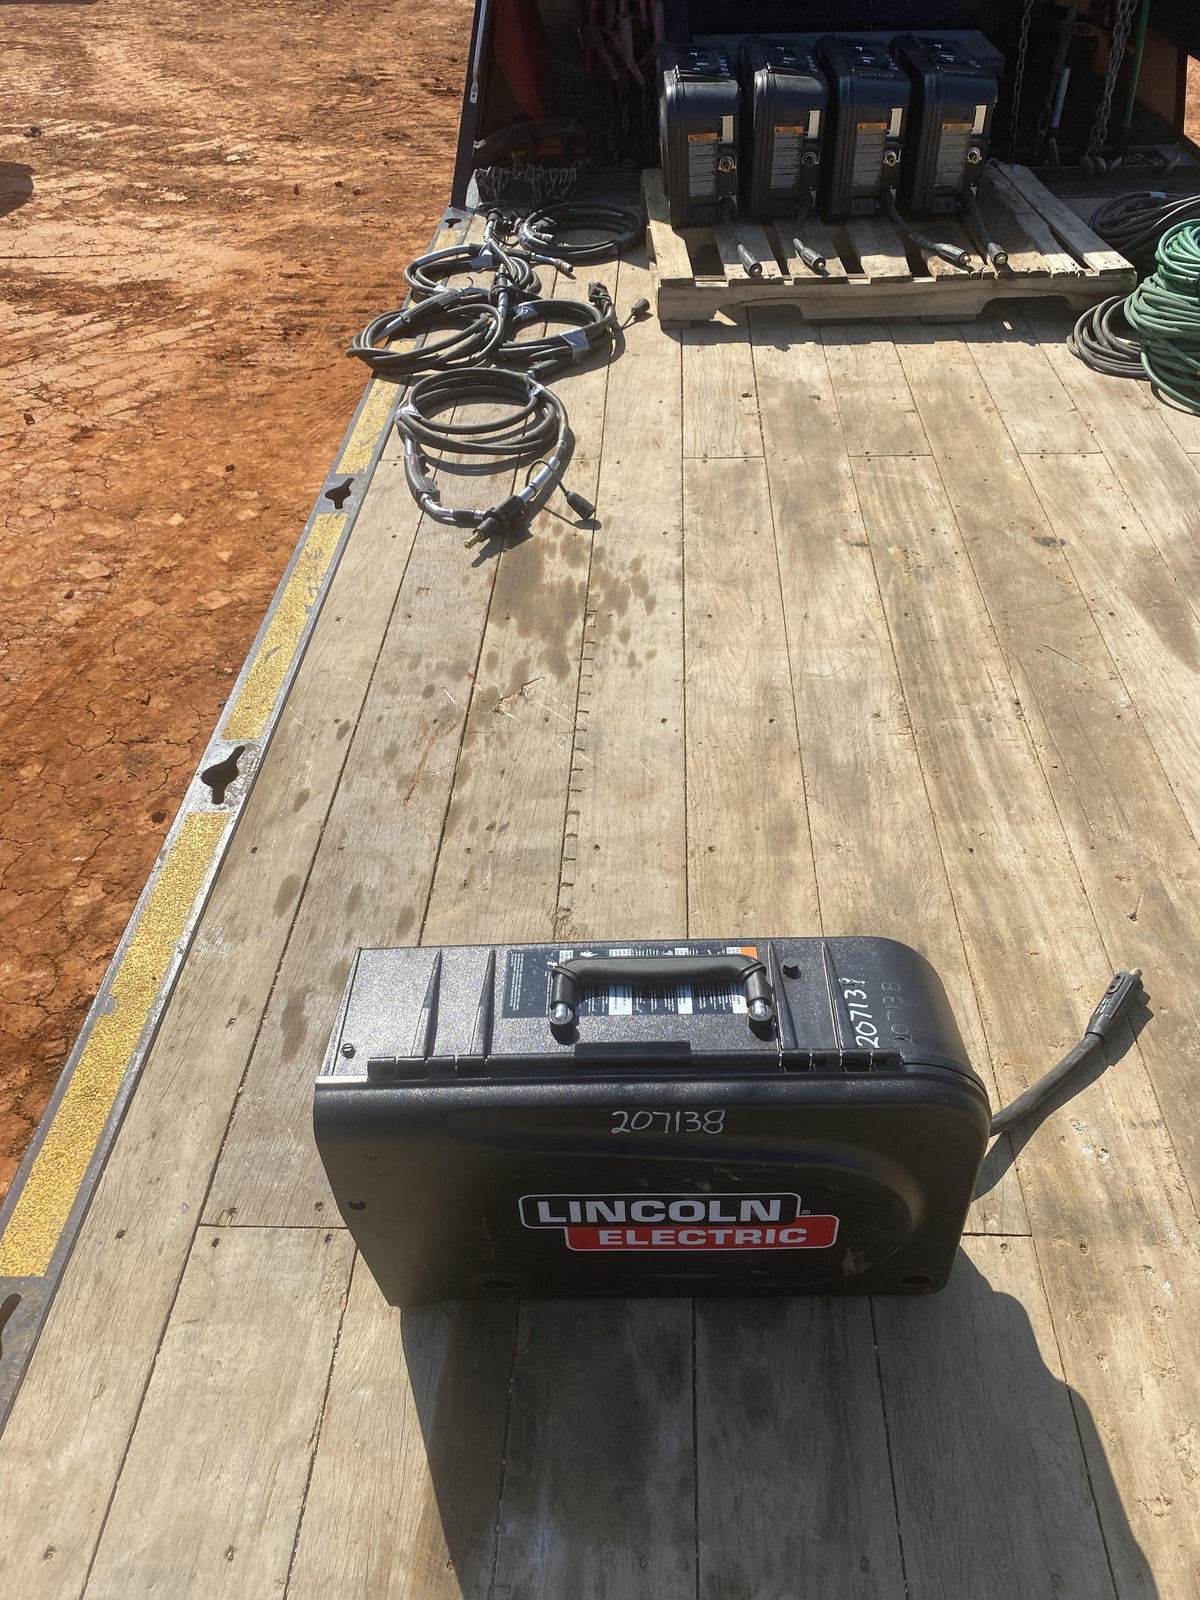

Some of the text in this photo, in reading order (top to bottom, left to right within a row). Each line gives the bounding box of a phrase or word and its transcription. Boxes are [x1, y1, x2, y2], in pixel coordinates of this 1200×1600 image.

[611, 1109, 725, 1134] 207138
[537, 1199, 781, 1223] LINCOLN
[599, 1227, 807, 1246] ELECTRIC
